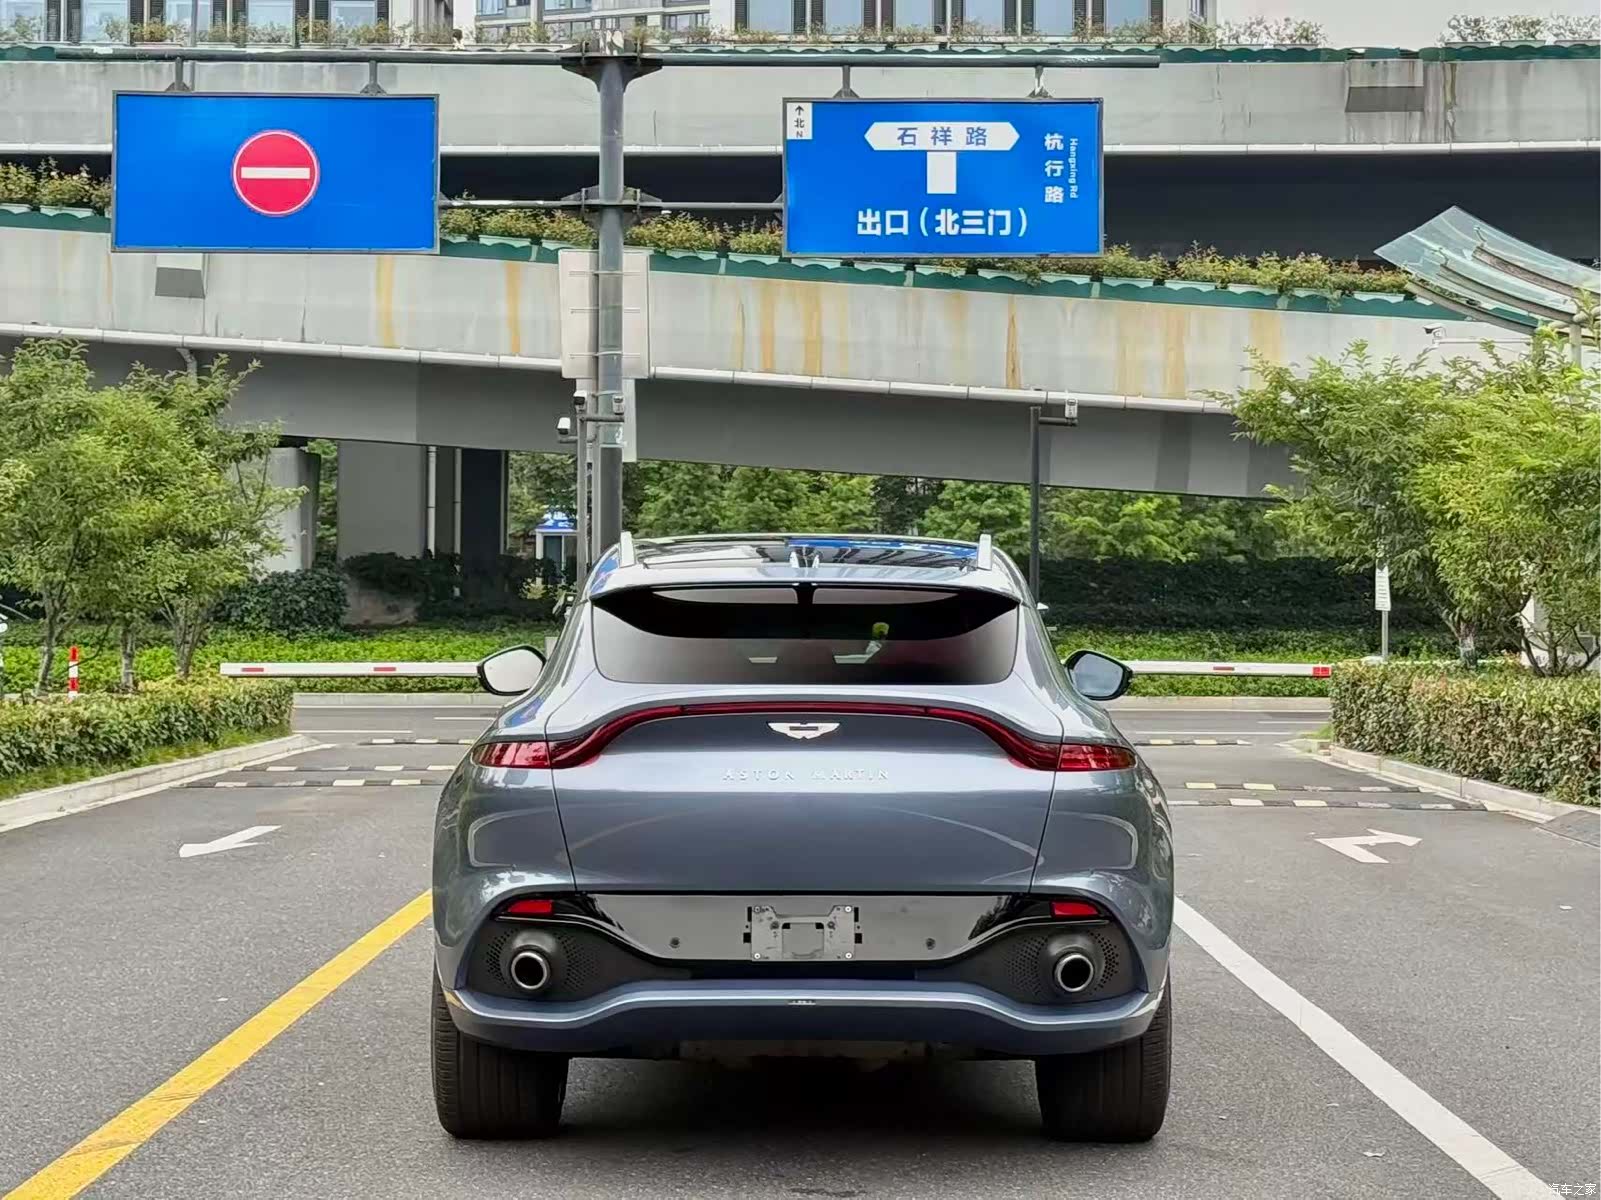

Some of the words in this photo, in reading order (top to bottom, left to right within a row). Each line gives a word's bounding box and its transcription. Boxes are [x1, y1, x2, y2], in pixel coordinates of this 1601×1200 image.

[794, 117, 805, 128] 北
[796, 130, 803, 138] N
[897, 126, 988, 147] 石祥路
[1044, 132, 1064, 204] 杭行路
[1068, 138, 1079, 184] Hangxing
[1069, 185, 1079, 199] Rd
[723, 769, 795, 781] ASTON
[811, 769, 889, 781] MARTIN
